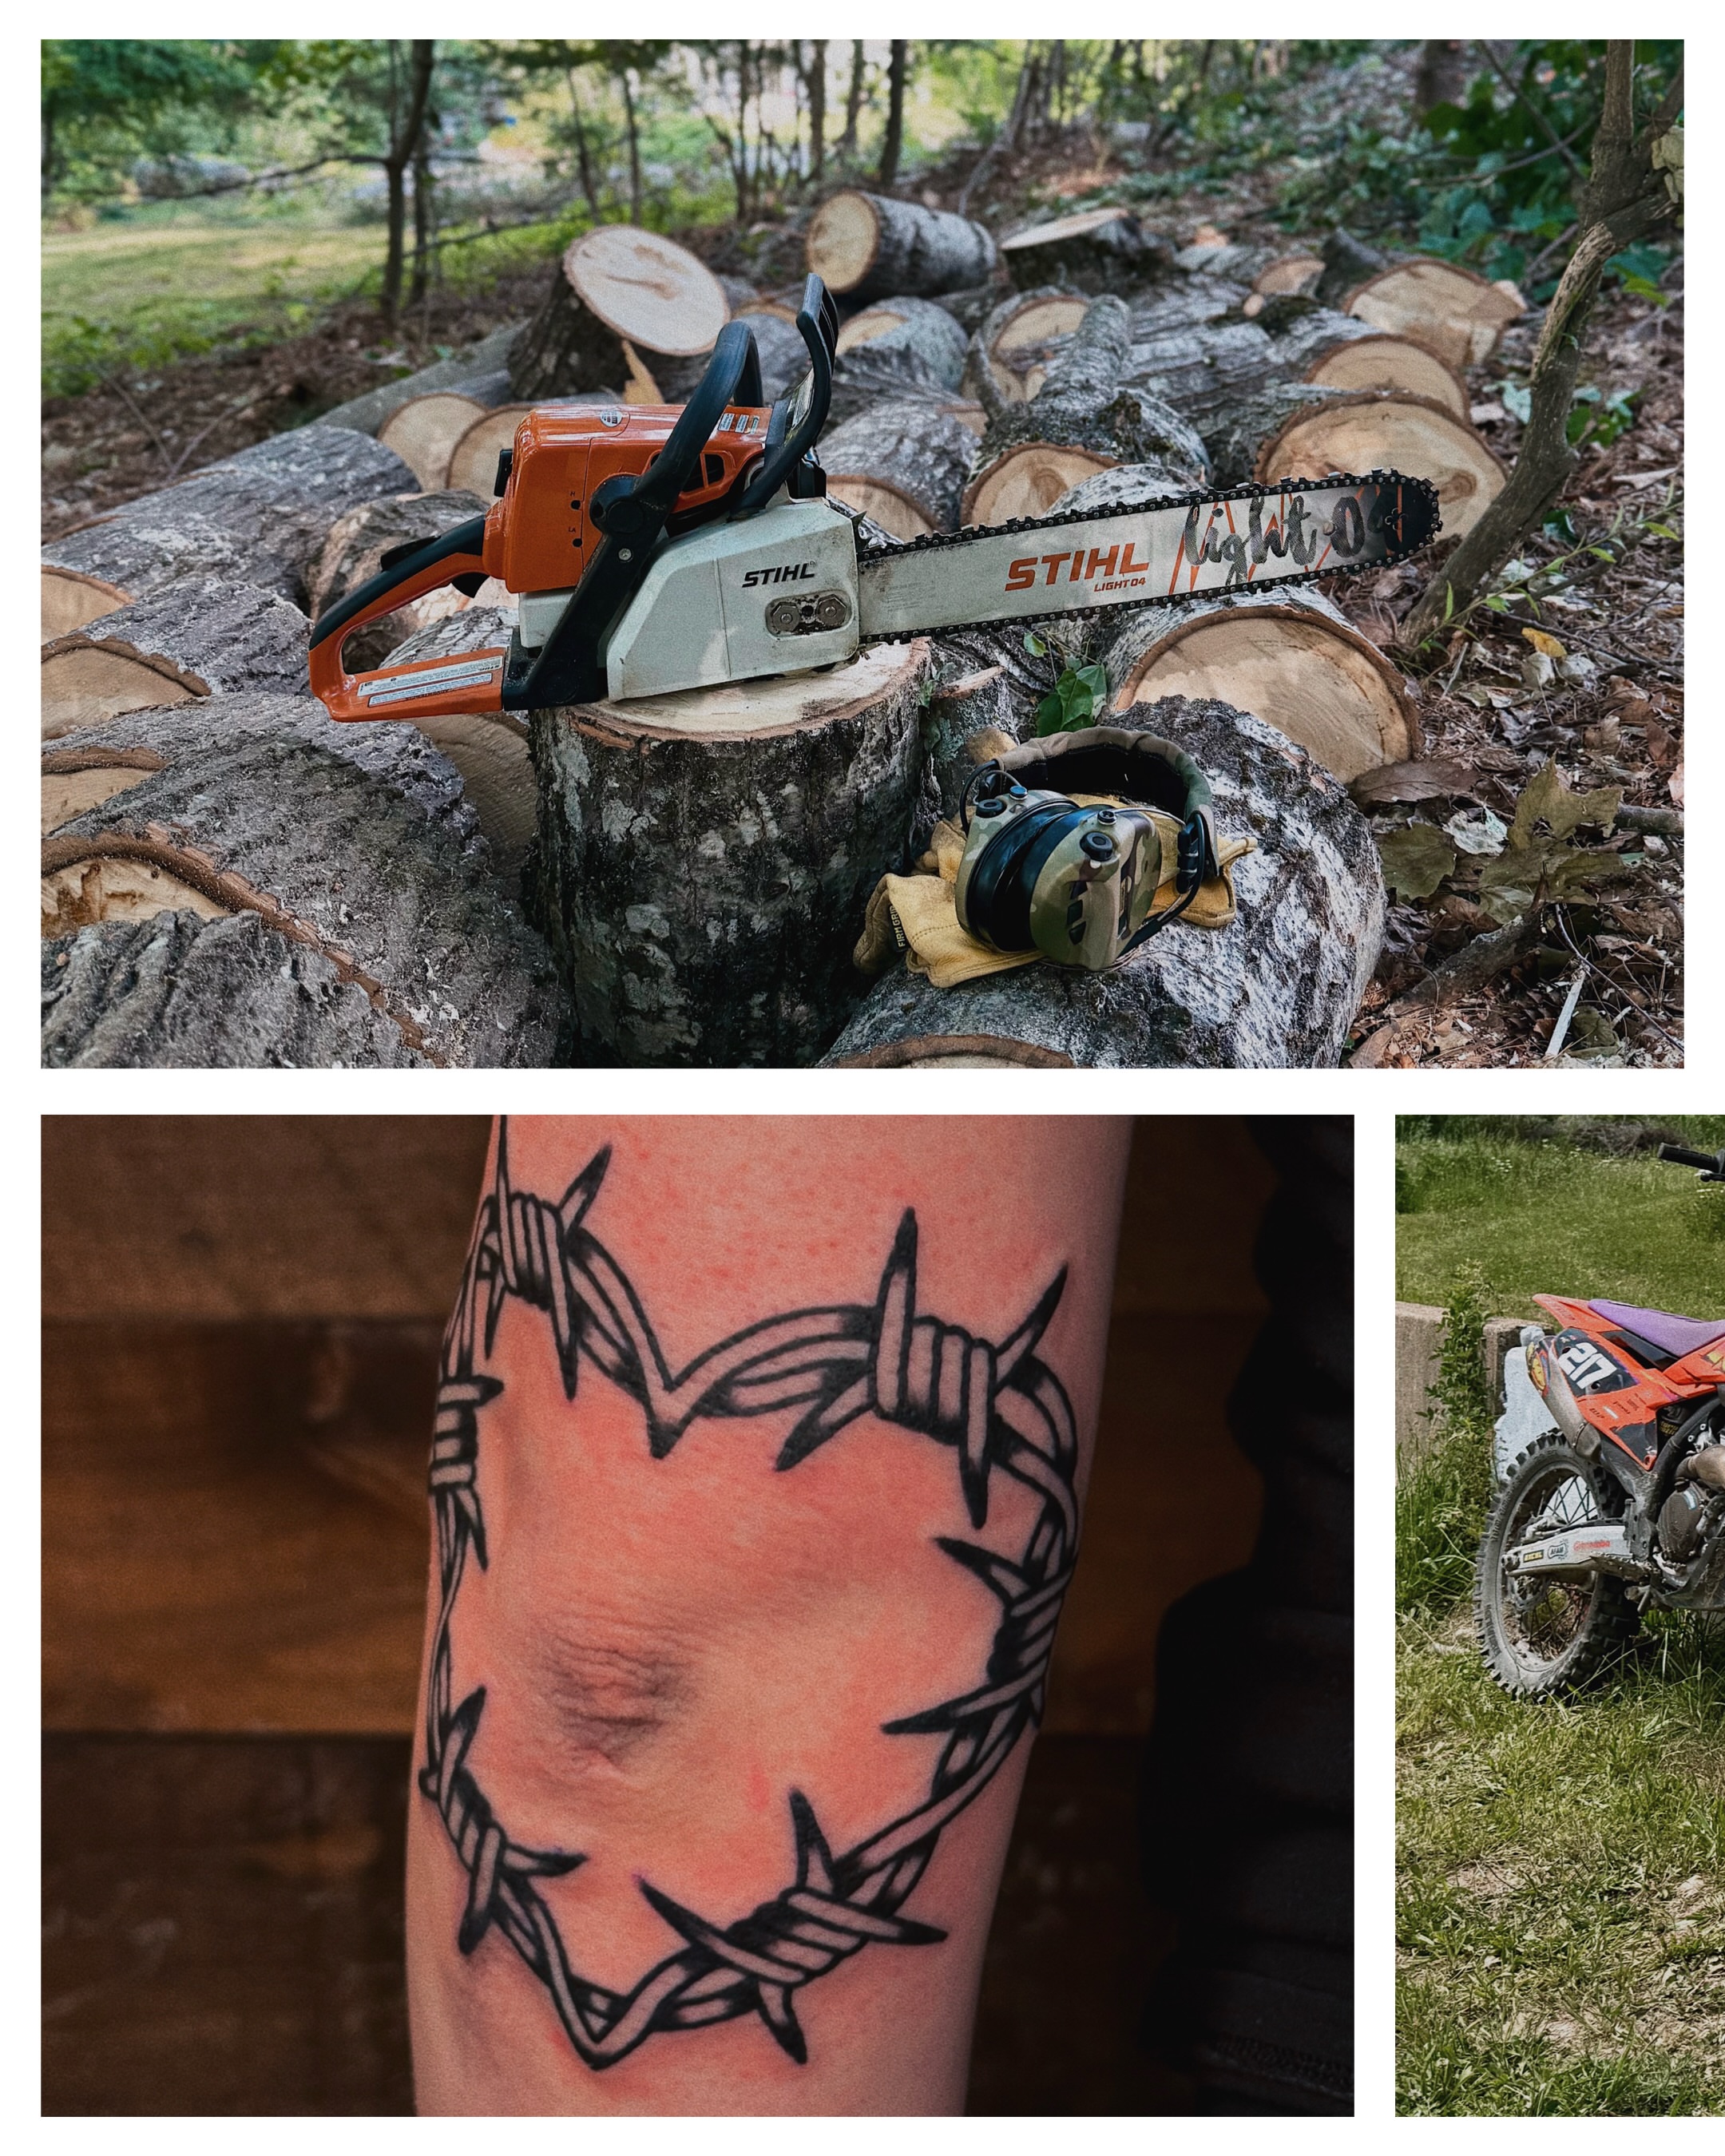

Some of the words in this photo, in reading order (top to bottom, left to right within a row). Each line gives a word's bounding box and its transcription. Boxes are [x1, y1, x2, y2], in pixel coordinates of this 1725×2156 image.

[742, 562, 815, 589] STIHL
[1005, 542, 1150, 592] STIHL
[1094, 579, 1129, 593] LIGHT
[1130, 577, 1147, 588] 04
[894, 926, 906, 948] FIRM
[1557, 1342, 1617, 1390] 217
